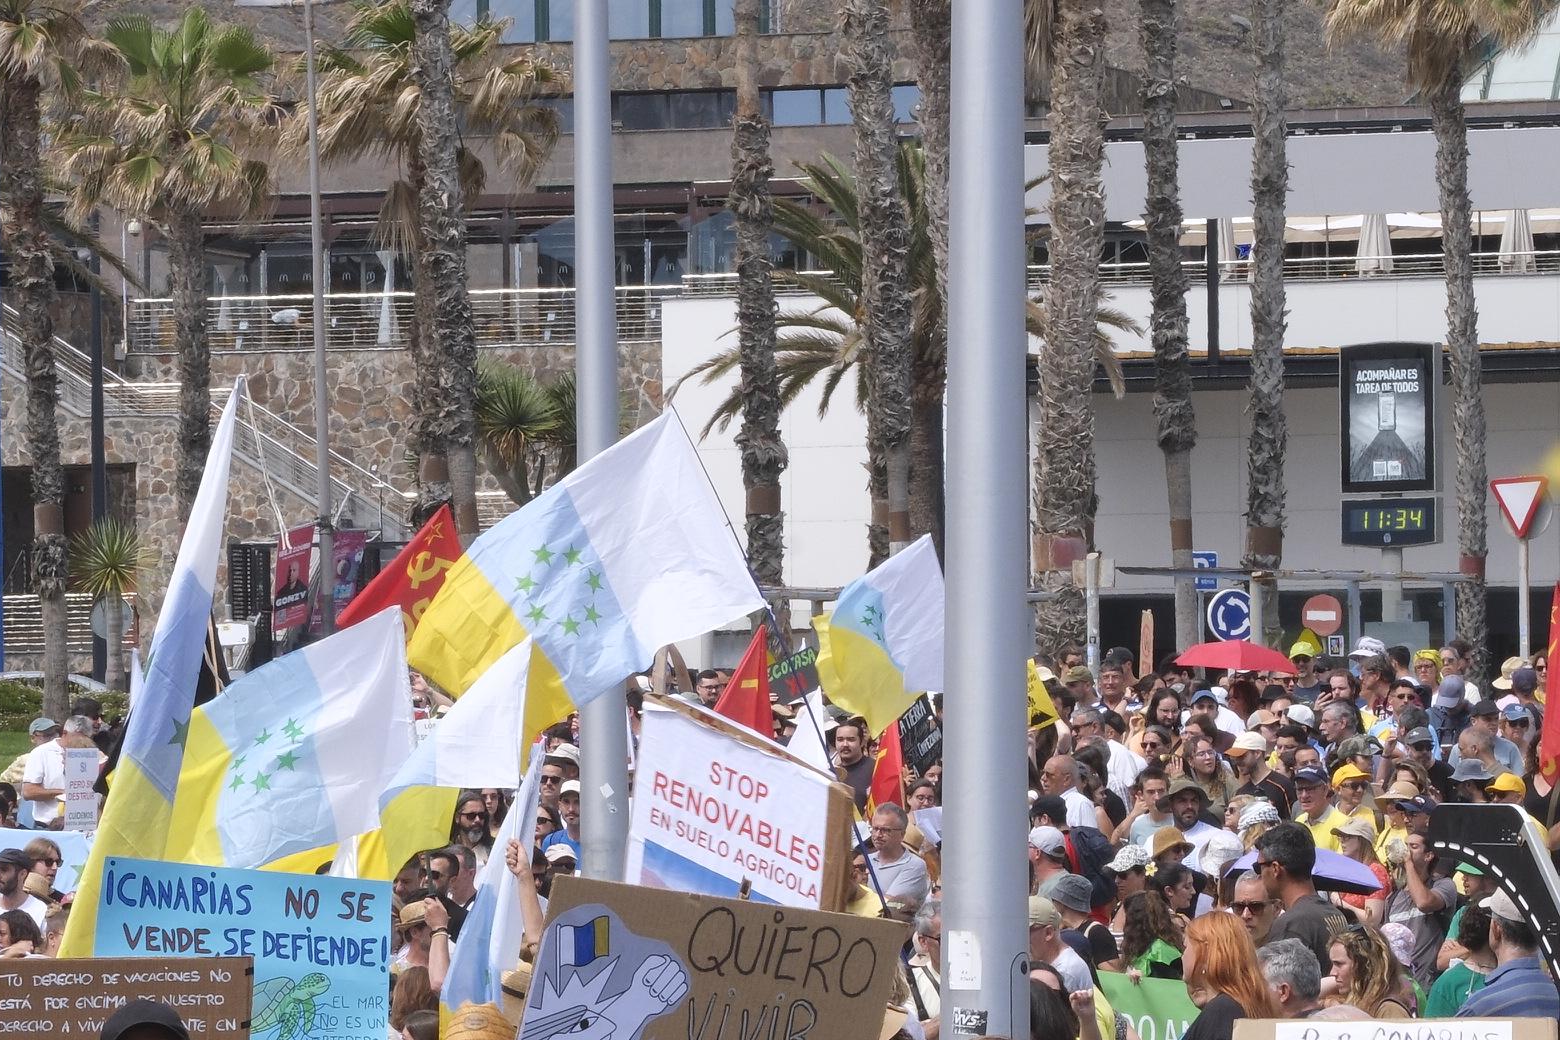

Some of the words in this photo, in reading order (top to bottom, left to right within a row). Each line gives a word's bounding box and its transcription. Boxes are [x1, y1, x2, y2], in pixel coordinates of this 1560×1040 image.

[1356, 367, 1407, 382] ACOMPAÑAR
[1407, 369, 1418, 380] ES
[1355, 382, 1381, 394] TAREA
[1393, 381, 1419, 393] TODOS
[1363, 509, 1422, 529] 11:34
[275, 591, 306, 607] GONZY
[709, 761, 768, 803] STOP
[653, 771, 820, 871] RENOVABLES
[650, 807, 671, 832] EN
[676, 820, 729, 858] SUELO
[733, 848, 819, 903] AGRÍCOLA
[284, 886, 320, 920] NO
[337, 891, 376, 923] SE
[223, 927, 257, 957] SE
[262, 926, 388, 973] DEFIENDE!
[687, 906, 877, 998] QUIERO
[32, 973, 94, 987] DERECHO
[103, 973, 119, 985] DE
[124, 966, 200, 984] VACACIONES
[209, 969, 232, 983] NO
[44, 996, 70, 1010] POR
[75, 992, 127, 1010] ENCIMA
[161, 993, 225, 1006] NUESTRO
[332, 996, 352, 1010] EL
[357, 996, 384, 1010] MAR
[61, 1021, 70, 1033] A
[77, 1017, 105, 1032] VIVI
[215, 1019, 237, 1031] EN
[320, 1012, 339, 1032] NO
[345, 1016, 361, 1030] ES
[368, 1016, 385, 1030] UN
